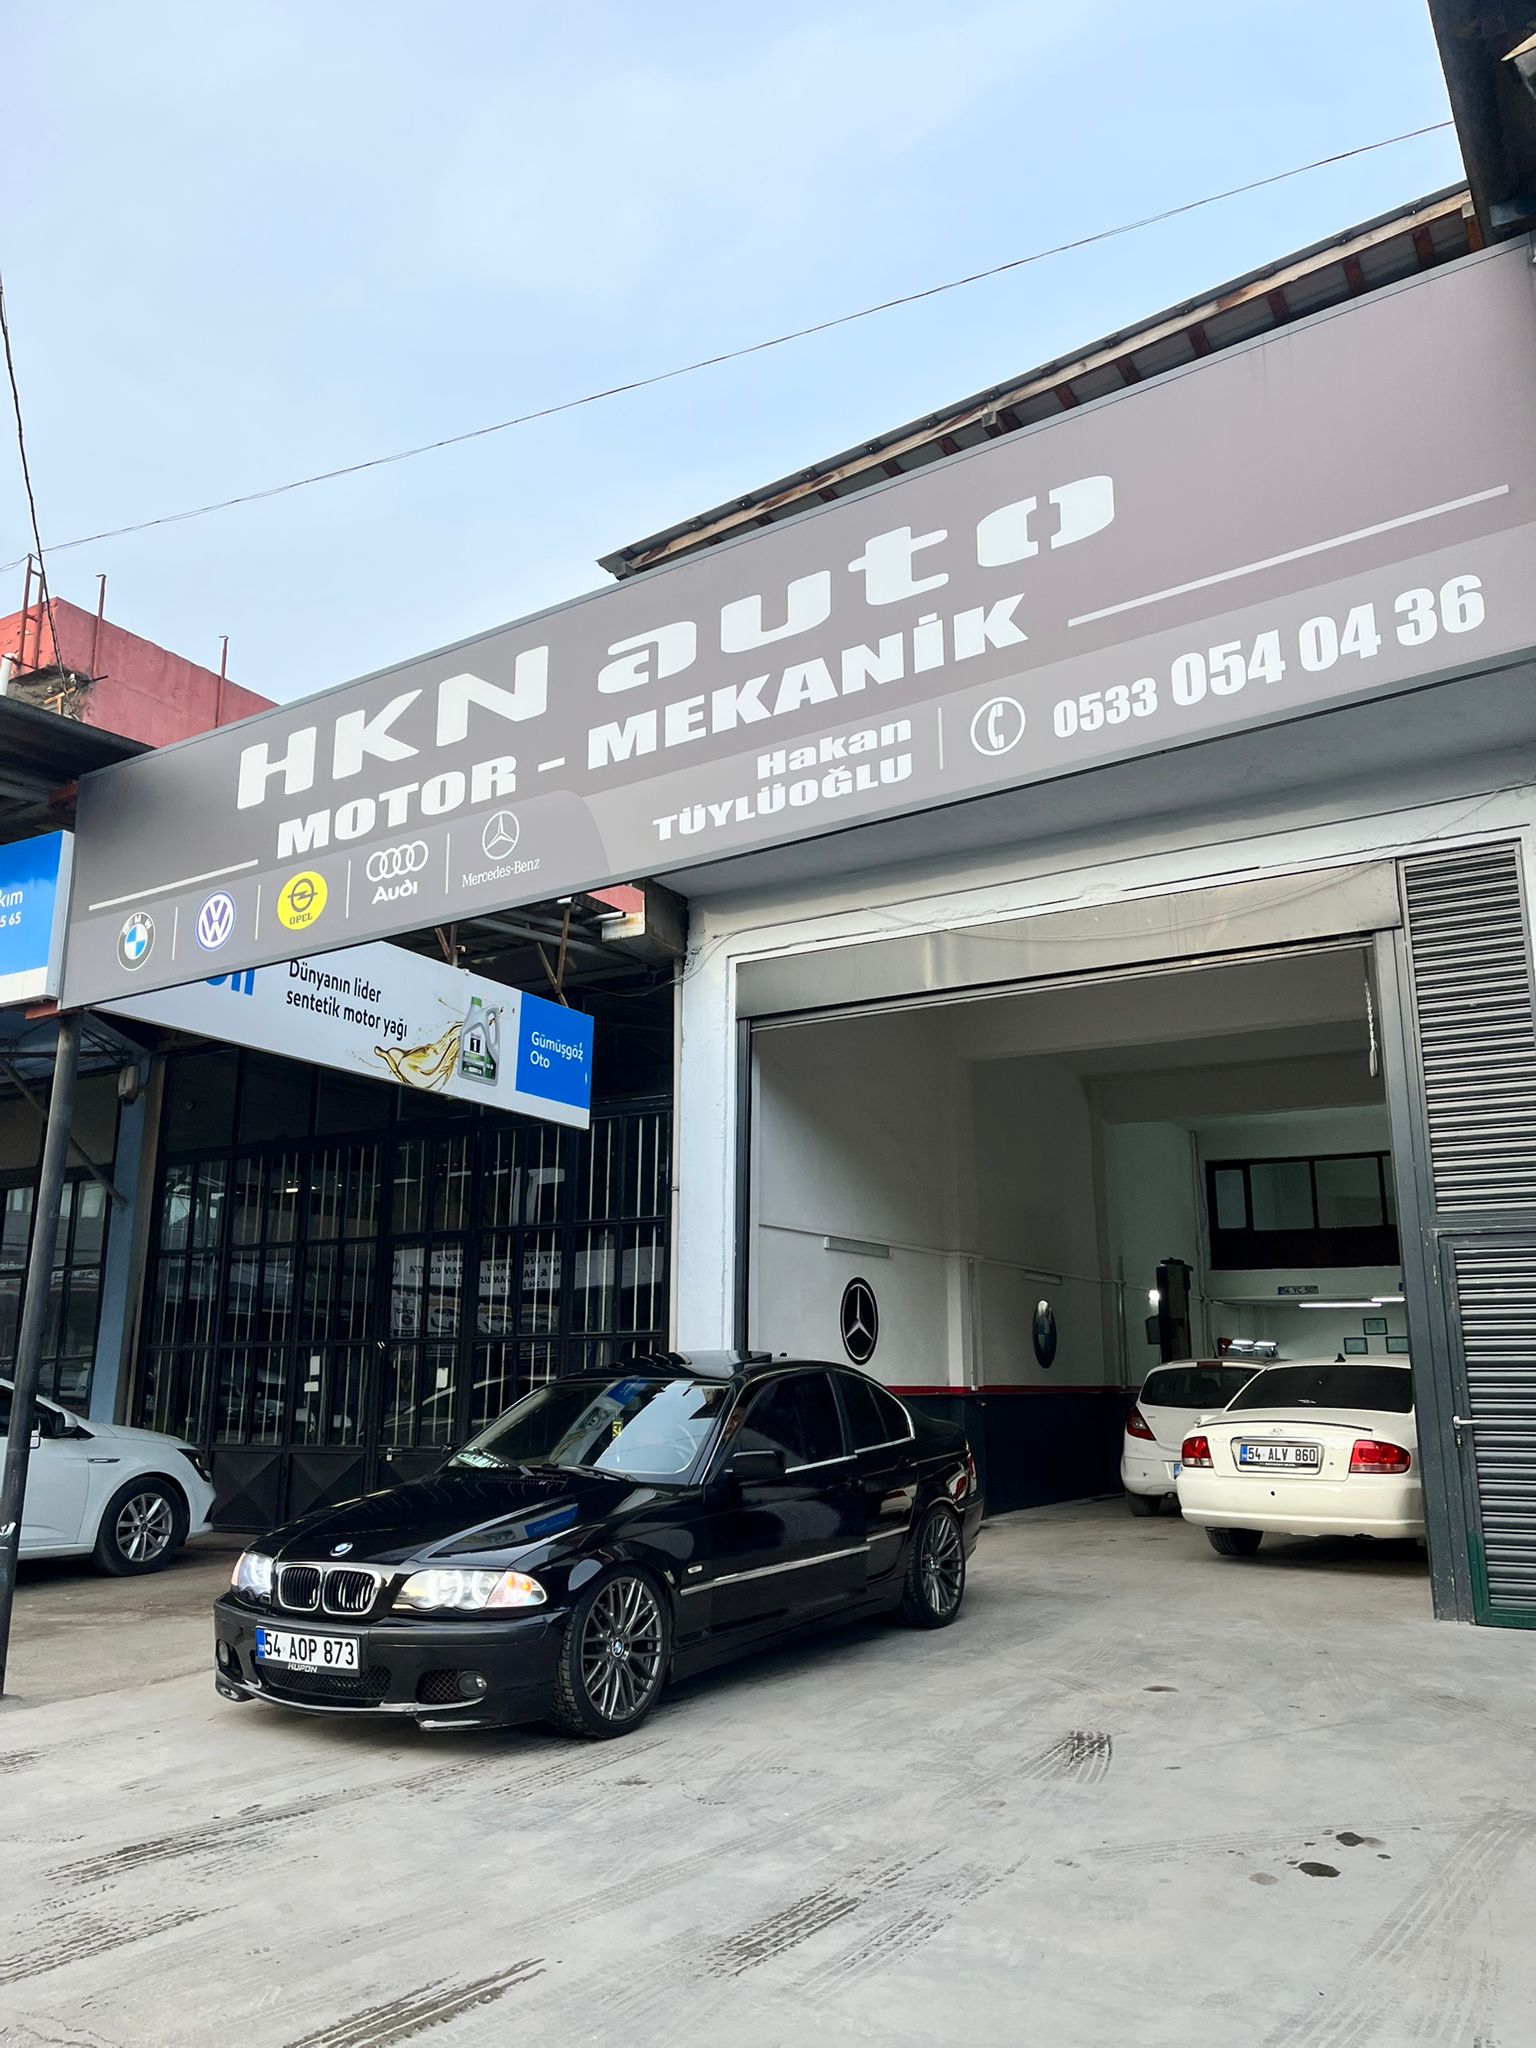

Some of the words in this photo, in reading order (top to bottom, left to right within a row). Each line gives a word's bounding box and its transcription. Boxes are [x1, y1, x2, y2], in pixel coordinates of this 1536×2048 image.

[237, 645, 549, 809] HKN
[598, 475, 1115, 693] auto
[1053, 678, 1158, 738] 0533
[1171, 629, 1286, 706] 054
[1299, 603, 1382, 672] 04
[1394, 574, 1485, 646] 36
[277, 756, 517, 859] MOTOR
[587, 593, 1029, 770] MEKANİK
[757, 719, 912, 780] Hakan
[652, 753, 912, 841] TÜYLÜOĞLU
[372, 879, 418, 904] Audi
[462, 858, 540, 888] Mercedes-Benz
[8, 911, 22, 926] 65
[289, 913, 313, 925] OPEL
[289, 959, 350, 994] Dünyanın
[353, 977, 381, 1003] lider
[286, 989, 340, 1018] sentetik
[343, 1005, 381, 1029] motor
[383, 1017, 408, 1041] yağı
[530, 1050, 550, 1069] Oto
[1248, 1448, 1261, 1460] 54
[1268, 1448, 1288, 1461] ALV
[1295, 1449, 1315, 1462] 860
[265, 1632, 281, 1657] 54
[289, 1637, 317, 1662] AOP
[324, 1640, 354, 1665] 873
